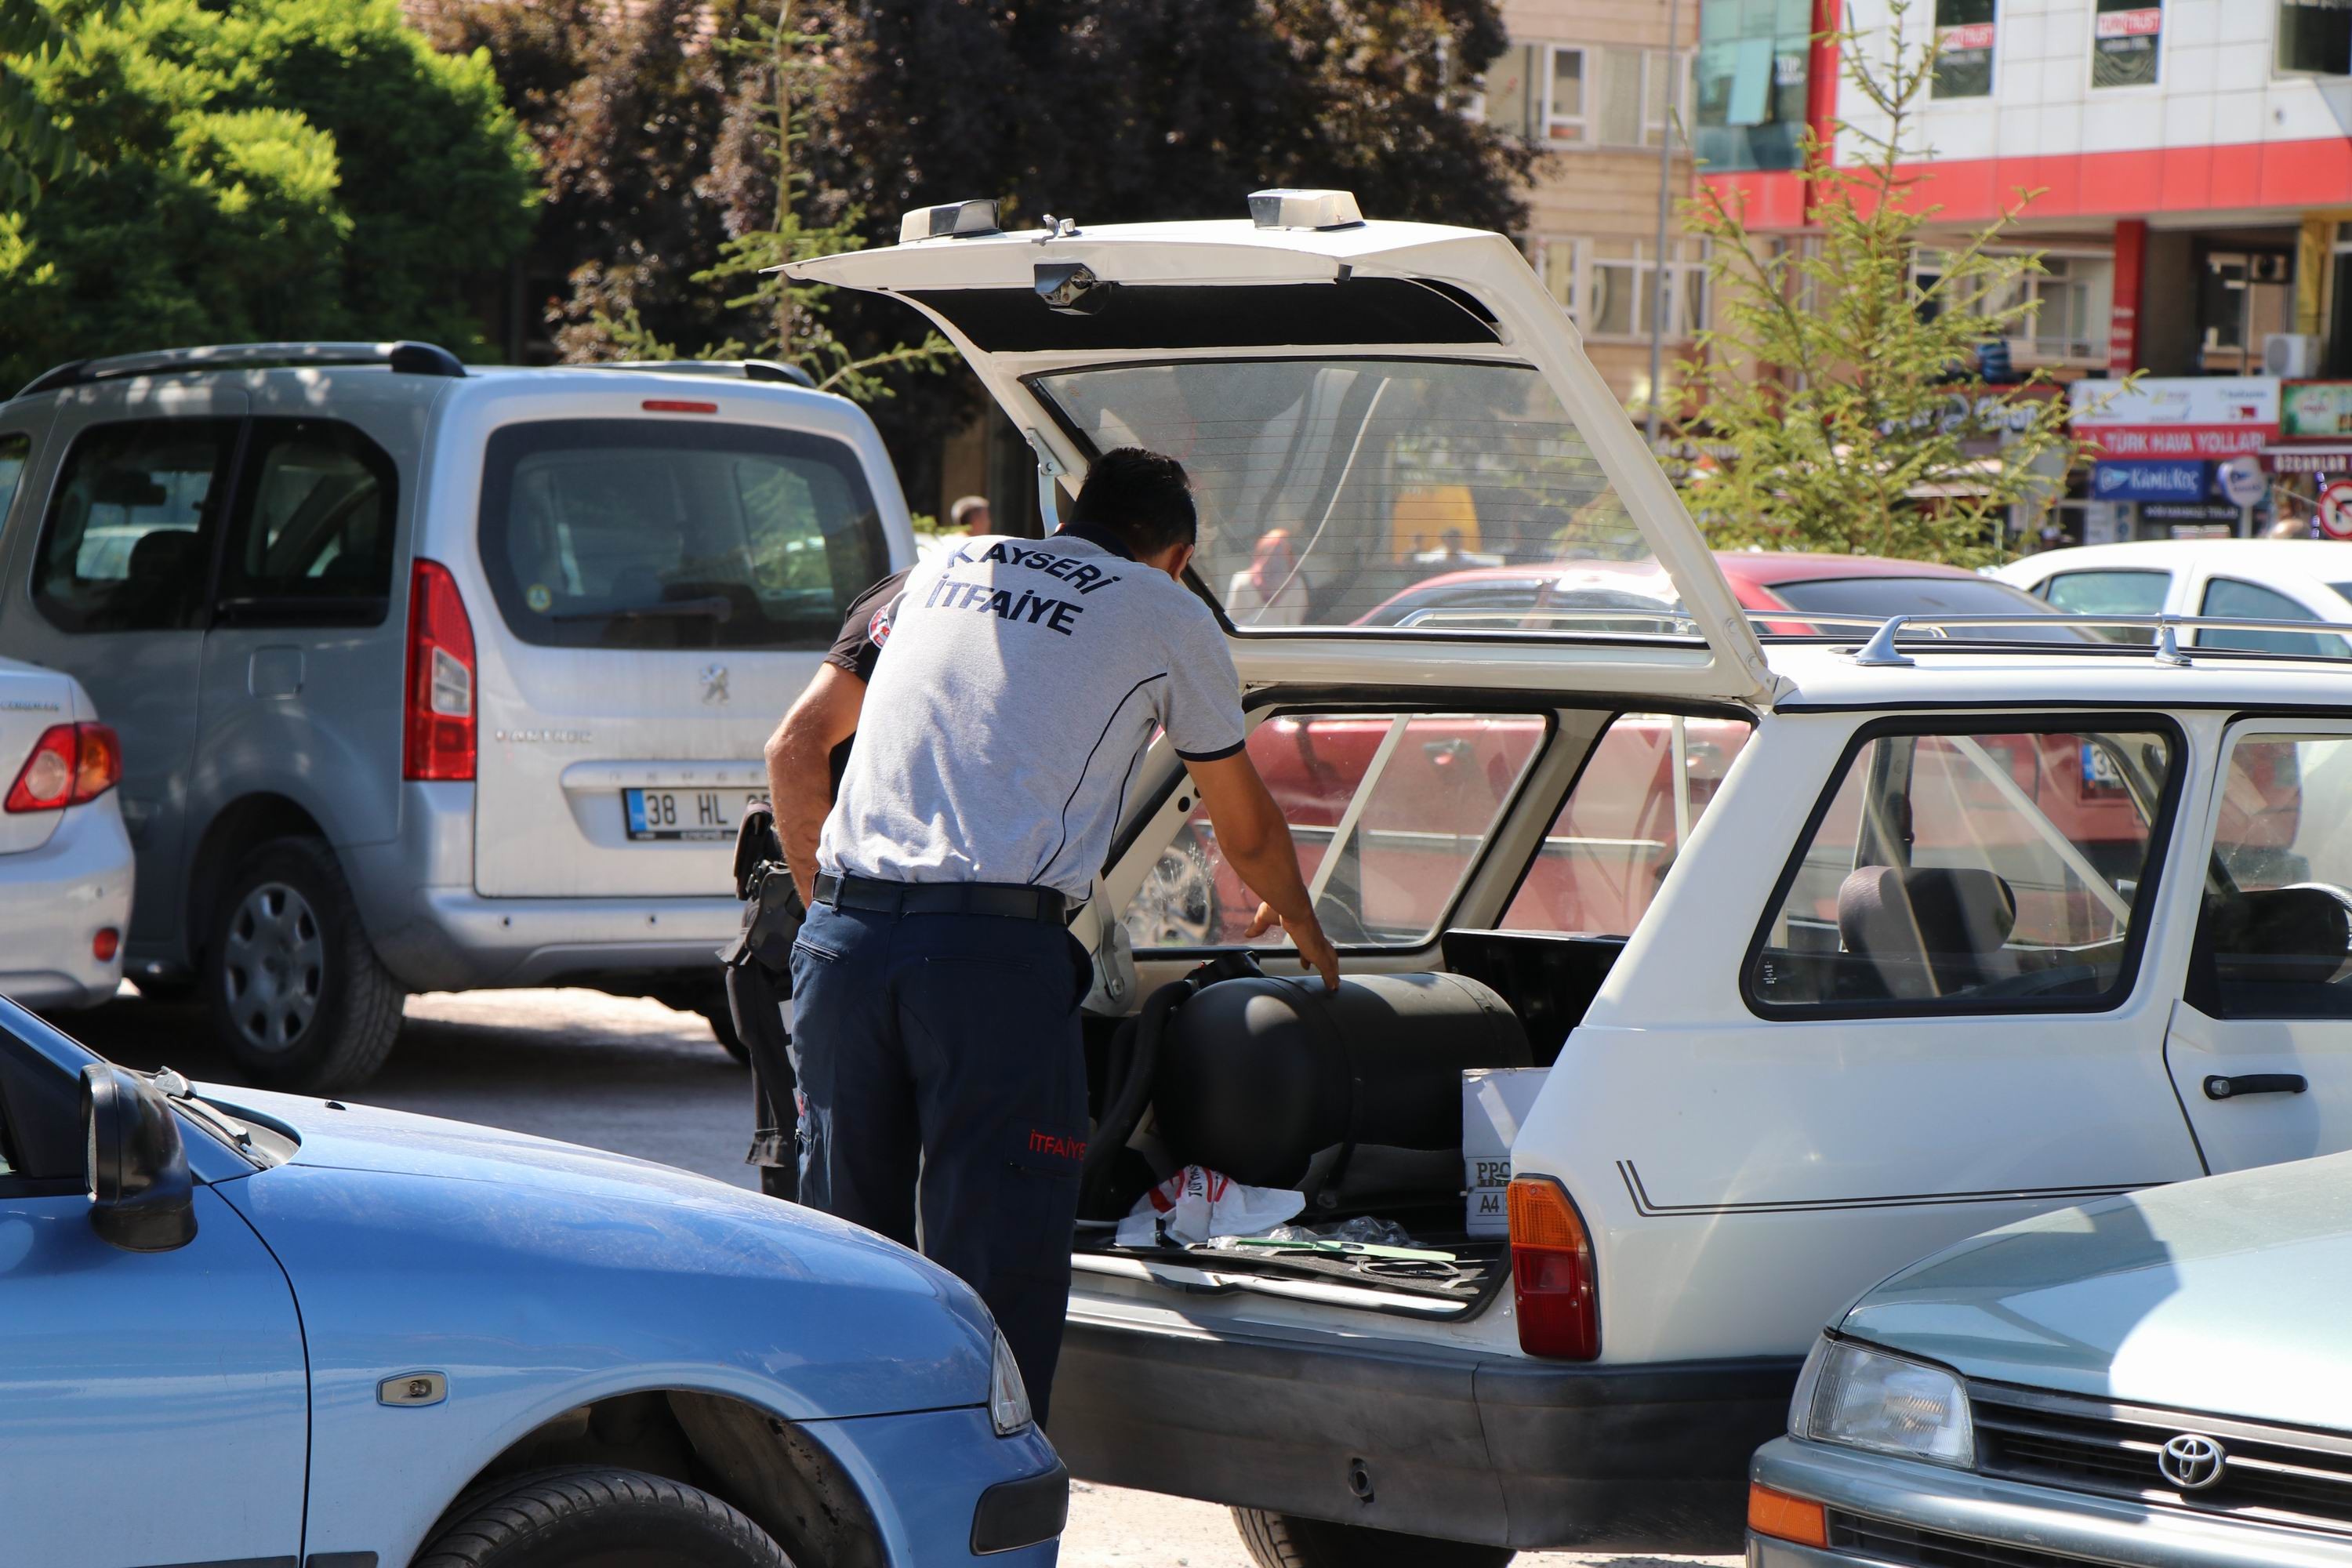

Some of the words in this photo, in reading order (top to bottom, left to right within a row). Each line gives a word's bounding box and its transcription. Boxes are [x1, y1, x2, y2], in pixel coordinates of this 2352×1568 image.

[2106, 430, 2147, 453] TÜRK
[2151, 431, 2194, 453] HAVA
[2198, 430, 2265, 454] YOLLARI
[947, 542, 1122, 595] KAYSERİ
[925, 573, 1083, 636] İTFAİYE
[646, 794, 677, 825] 38
[698, 793, 728, 825] HL
[1479, 1194, 1500, 1214] A4
